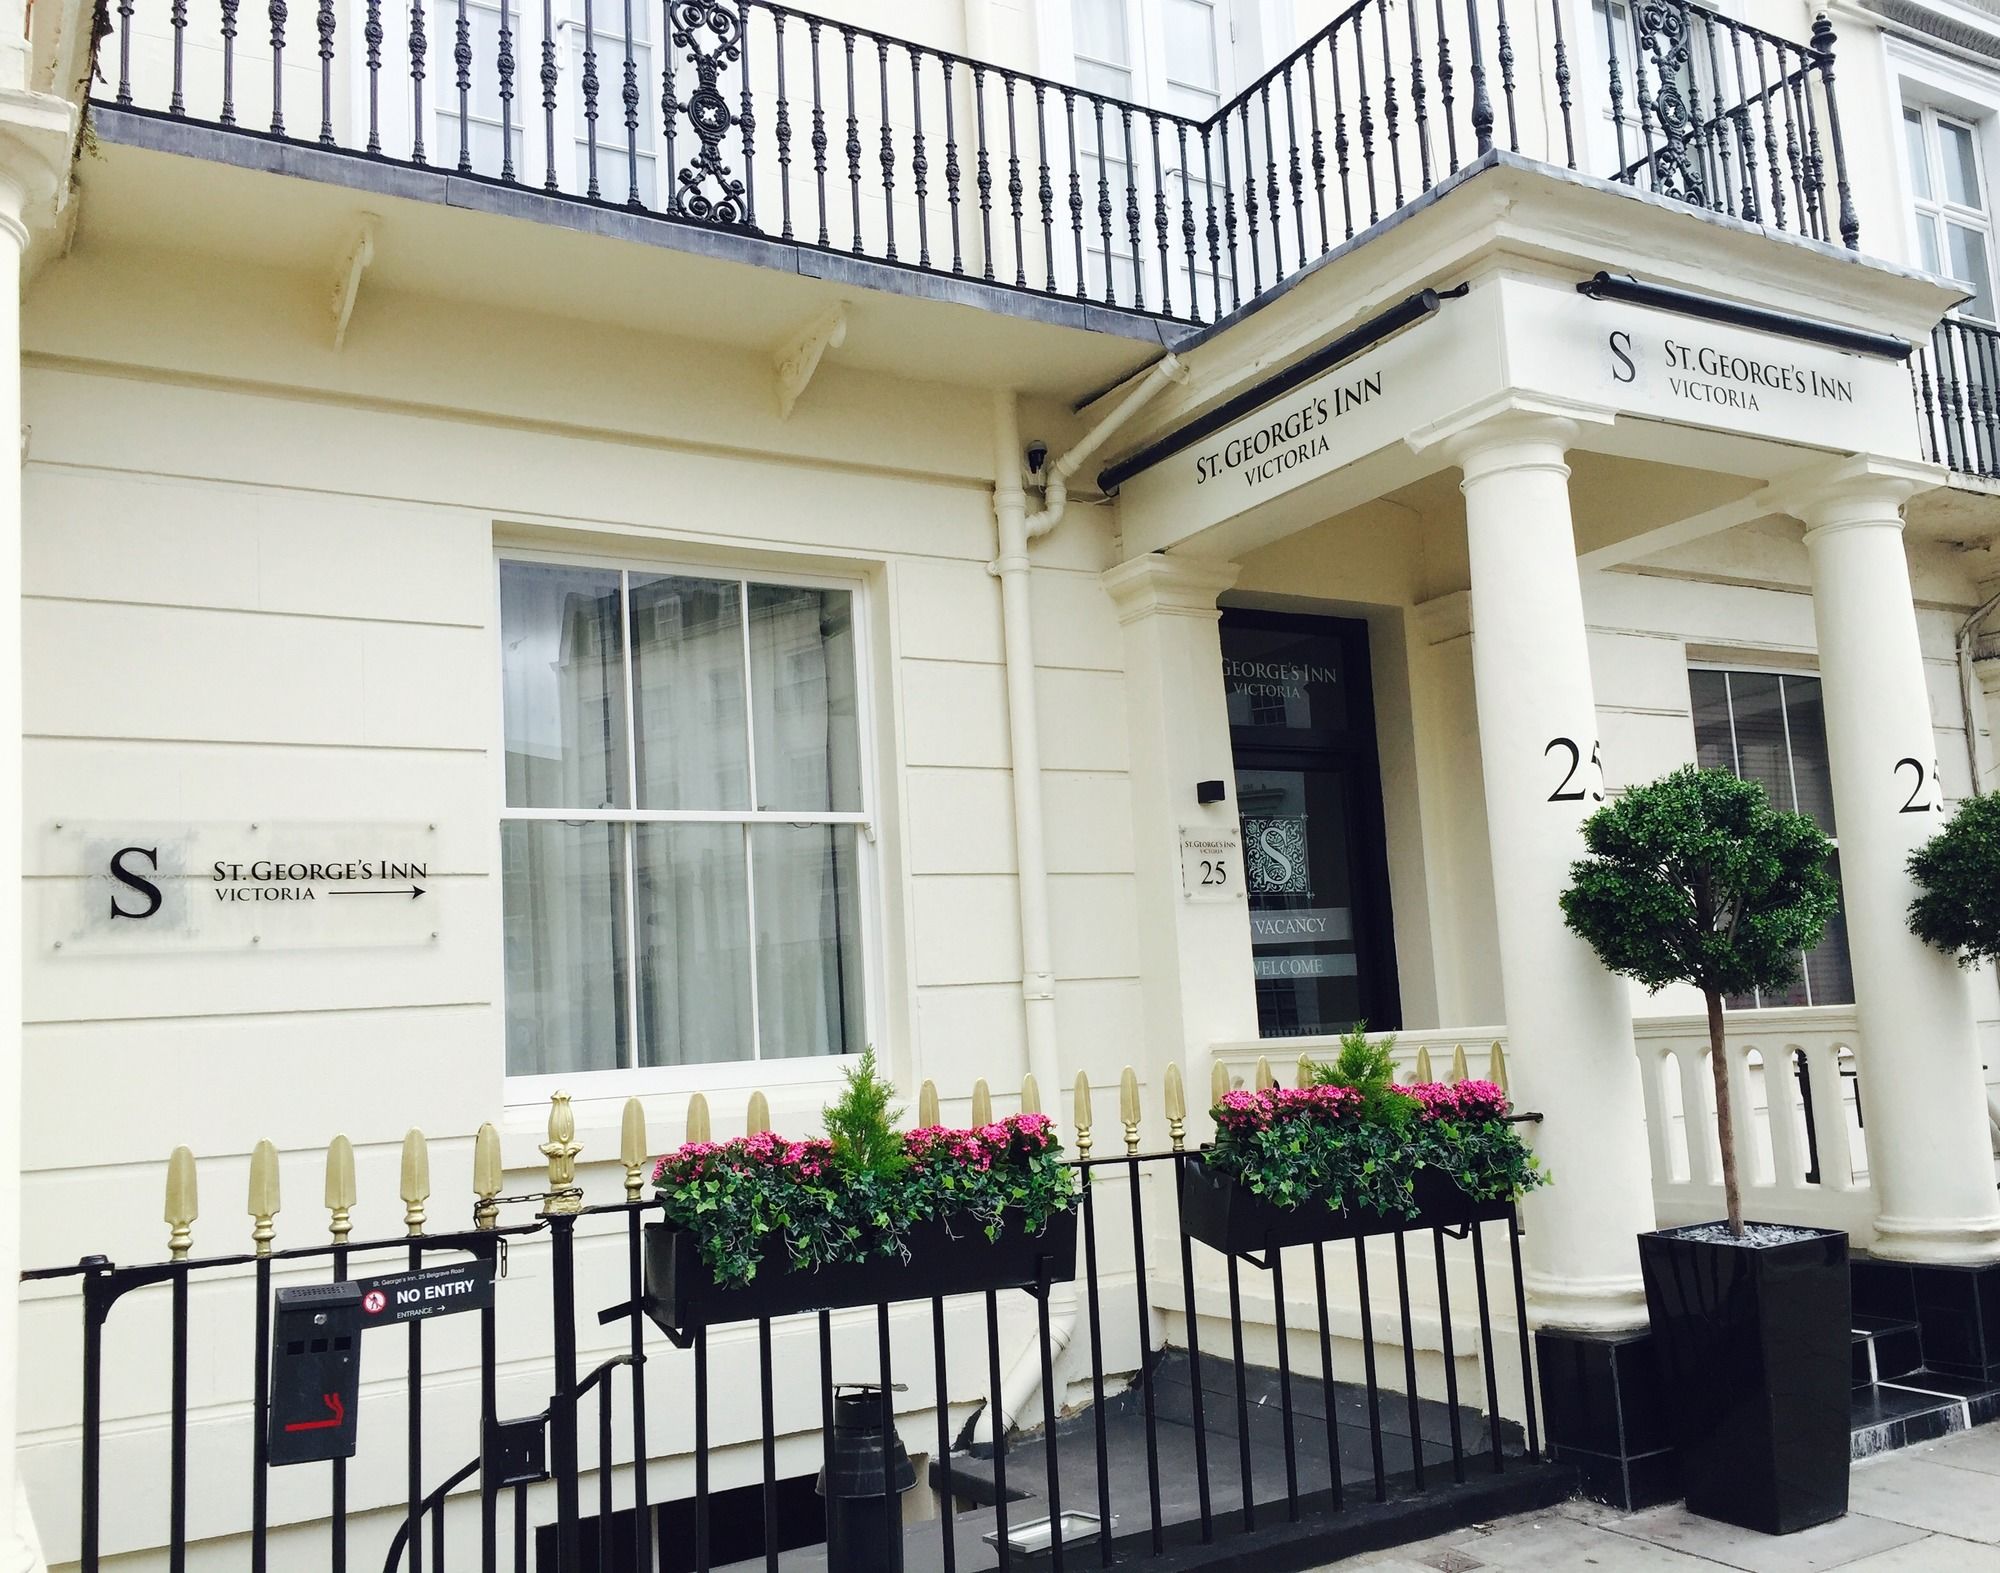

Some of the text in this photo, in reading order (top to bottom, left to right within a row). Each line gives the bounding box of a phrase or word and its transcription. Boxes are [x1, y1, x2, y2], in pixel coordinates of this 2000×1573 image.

[1609, 331, 1636, 383] S
[1334, 371, 1382, 417] INN
[1669, 377, 1760, 412] VICTORIA
[1810, 370, 1854, 403] INN
[1244, 434, 1330, 487] VICTORIA
[1304, 664, 1337, 683] INN
[1233, 682, 1301, 698] VICTORIA
[380, 860, 428, 879] INN
[1200, 860, 1227, 885] 25
[110, 847, 162, 919] S
[215, 886, 316, 902] VICTORIA
[1255, 917, 1327, 935] VACANCY
[381, 1275, 406, 1286] George's
[426, 1270, 450, 1280] Belgrave
[450, 1267, 465, 1275] Road
[396, 1279, 475, 1304] NO ENTRY
[396, 1306, 433, 1319] ENTRANCE
